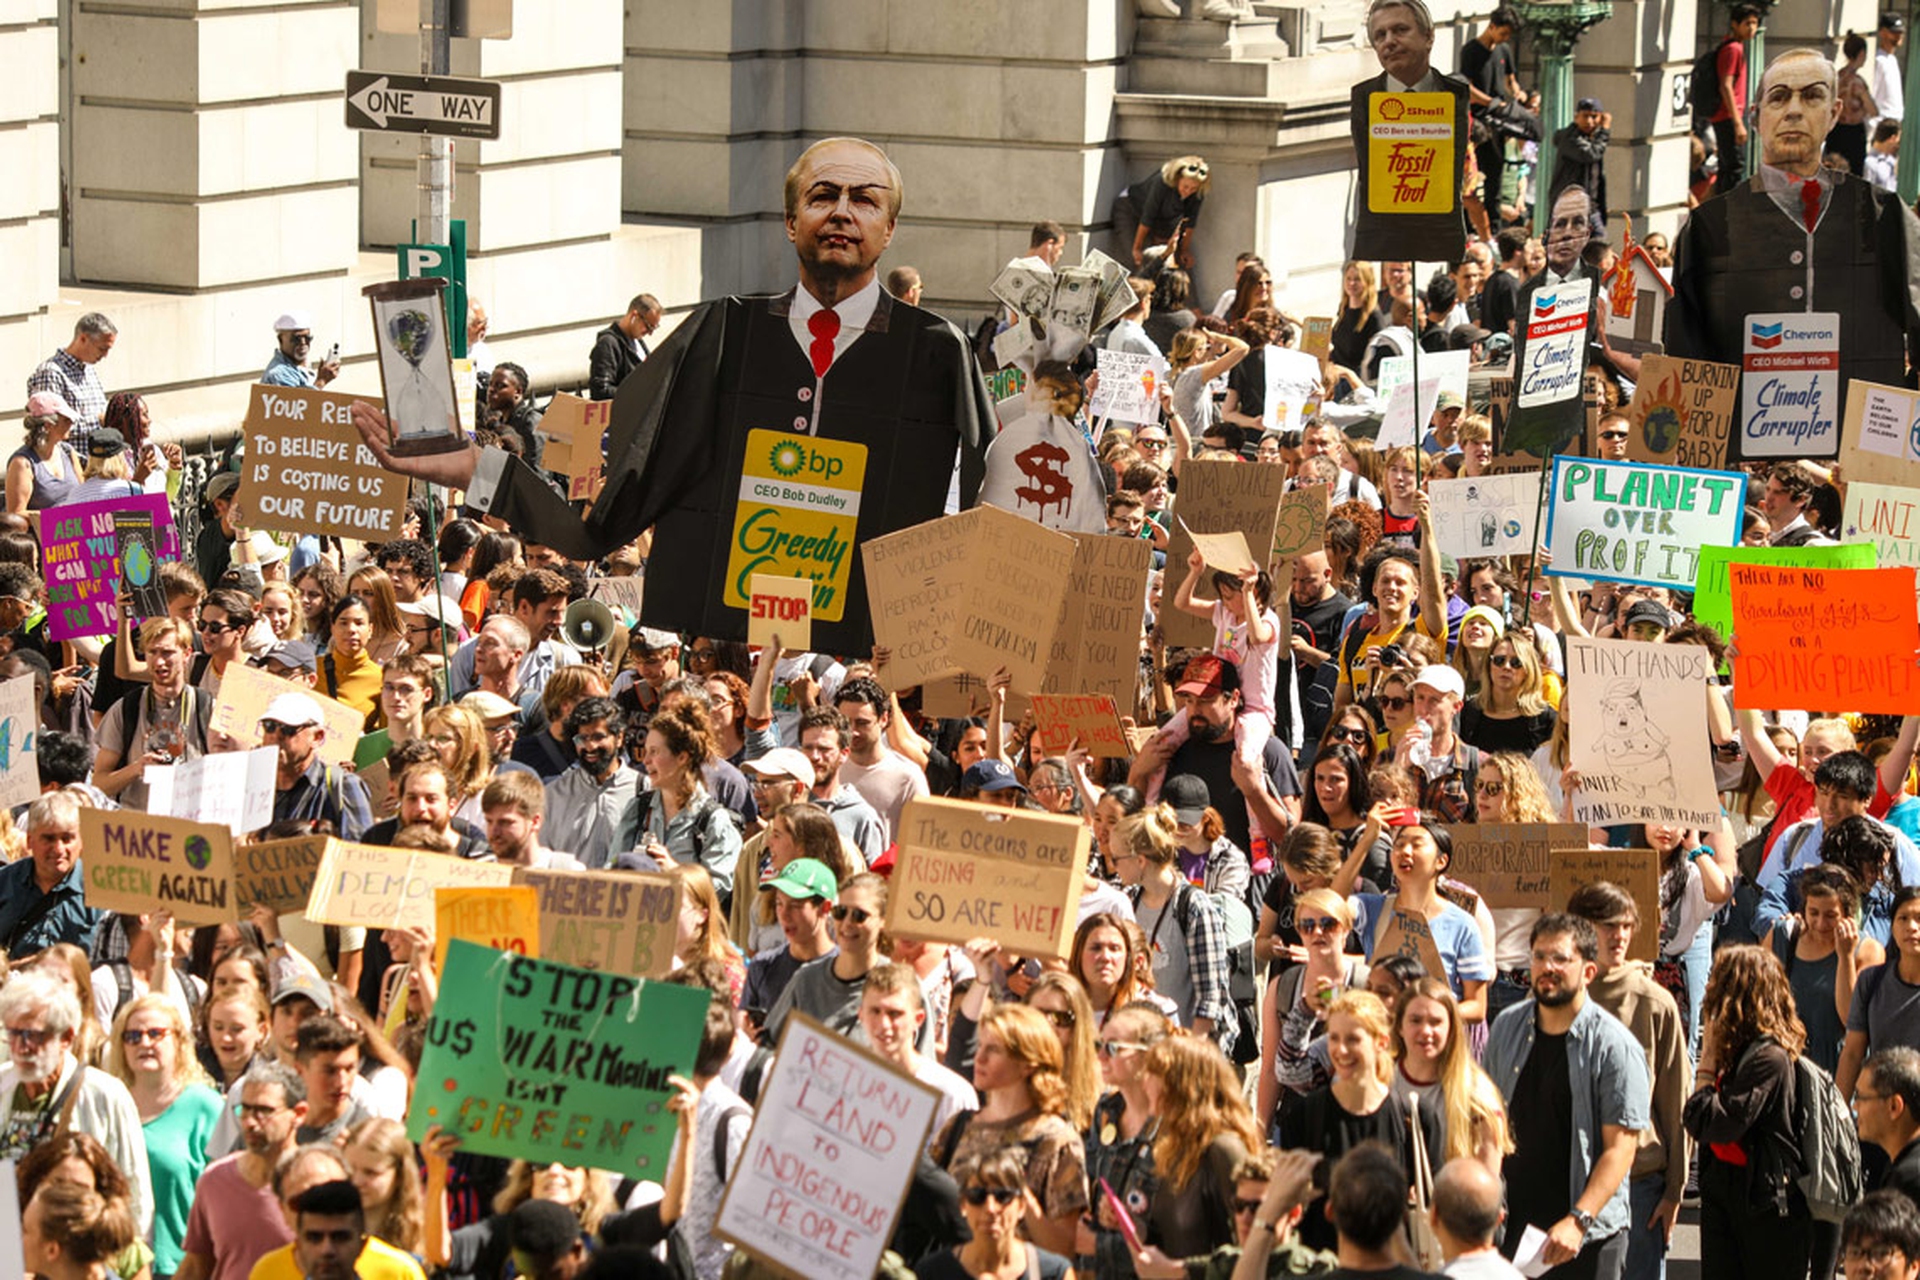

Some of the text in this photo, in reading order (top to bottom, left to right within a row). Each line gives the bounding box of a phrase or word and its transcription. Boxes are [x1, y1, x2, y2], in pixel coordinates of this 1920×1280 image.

[367, 91, 486, 120] ONE WAY
[1406, 107, 1445, 115] Shell
[1372, 127, 1389, 135] CEO
[1391, 127, 1405, 135] Ben
[1421, 127, 1451, 135] Beurden
[1387, 143, 1436, 173] Fossil
[1392, 173, 1430, 203] Fool
[407, 248, 442, 277] P
[1557, 296, 1586, 308] Chevron
[1533, 317, 1583, 335] CEO Michael Wirth
[1783, 329, 1833, 340] Chevron
[1534, 334, 1575, 368] Climate
[1752, 356, 1830, 367] CEO Michael Wirth
[1523, 361, 1578, 397] Corrupter
[1757, 374, 1822, 409] Climate
[262, 393, 308, 420] YOUR
[1694, 388, 1713, 408] UP
[1871, 404, 1892, 413] EARTH
[1872, 396, 1885, 404] THE
[1687, 410, 1730, 439] FOR U
[1746, 405, 1832, 446] Corrupter
[1870, 412, 1898, 423] BELONGS
[1867, 427, 1898, 438] CHILDREN
[281, 436, 349, 461] BELIEVE
[1677, 438, 1725, 469] BABY
[808, 449, 843, 480] bp
[253, 464, 383, 496] IS COSTING US
[1563, 463, 1734, 516] PLANET
[754, 484, 847, 510] CEO Bob Dudley
[54, 517, 84, 540] ASK
[91, 512, 115, 536] NO
[259, 495, 394, 531] OUR FUTURE
[1603, 507, 1677, 536] OVER
[45, 541, 80, 564] WHAT
[738, 508, 849, 581] Greedy
[1104, 541, 1151, 572] LOUD
[55, 560, 87, 580] CAN
[90, 558, 108, 578] DO
[895, 543, 966, 579] VIOLENCE
[49, 584, 75, 603] ASK
[1071, 572, 1138, 601] WE NEED
[1803, 572, 1825, 589] NO
[63, 604, 92, 630] FOR
[751, 594, 808, 622] STOP
[1085, 602, 1133, 633] SHOUT
[1741, 591, 1880, 633] broadway gigs
[965, 614, 1037, 664] CAPITALISM
[1085, 640, 1117, 667] YOU
[1789, 634, 1822, 648] ON A
[1573, 644, 1706, 680] TINY HANDS
[1745, 650, 1917, 698] DYING PLANET
[1039, 723, 1070, 747] HOT
[1577, 802, 1718, 824] PLAN TO SAVE THE PLANET
[103, 822, 172, 863] MAKE
[917, 819, 1071, 864] The oceans are
[249, 841, 319, 874] OCEANS
[345, 848, 507, 882] THIS IS WHAT
[91, 864, 227, 909] GREEN AGAIN
[250, 874, 296, 900] WILL
[907, 855, 1043, 892] RISING and
[351, 901, 424, 920] LOOKS
[525, 874, 676, 923] THERE IS NO
[440, 893, 513, 936] THERE
[908, 890, 1061, 941] SO ARE WE!
[1396, 913, 1429, 938] THERE
[633, 922, 657, 973] B
[504, 957, 636, 1016] STOP
[541, 1010, 584, 1031] THE
[503, 1025, 593, 1080] WAR
[506, 1078, 567, 1106] ISNT
[799, 1036, 911, 1119] RETURN
[459, 1095, 636, 1154] GREEN
[797, 1080, 896, 1153] LAND
[814, 1134, 839, 1162] TO
[754, 1140, 889, 1234] INDIGENOUS
[764, 1188, 861, 1259] PEOPLE
